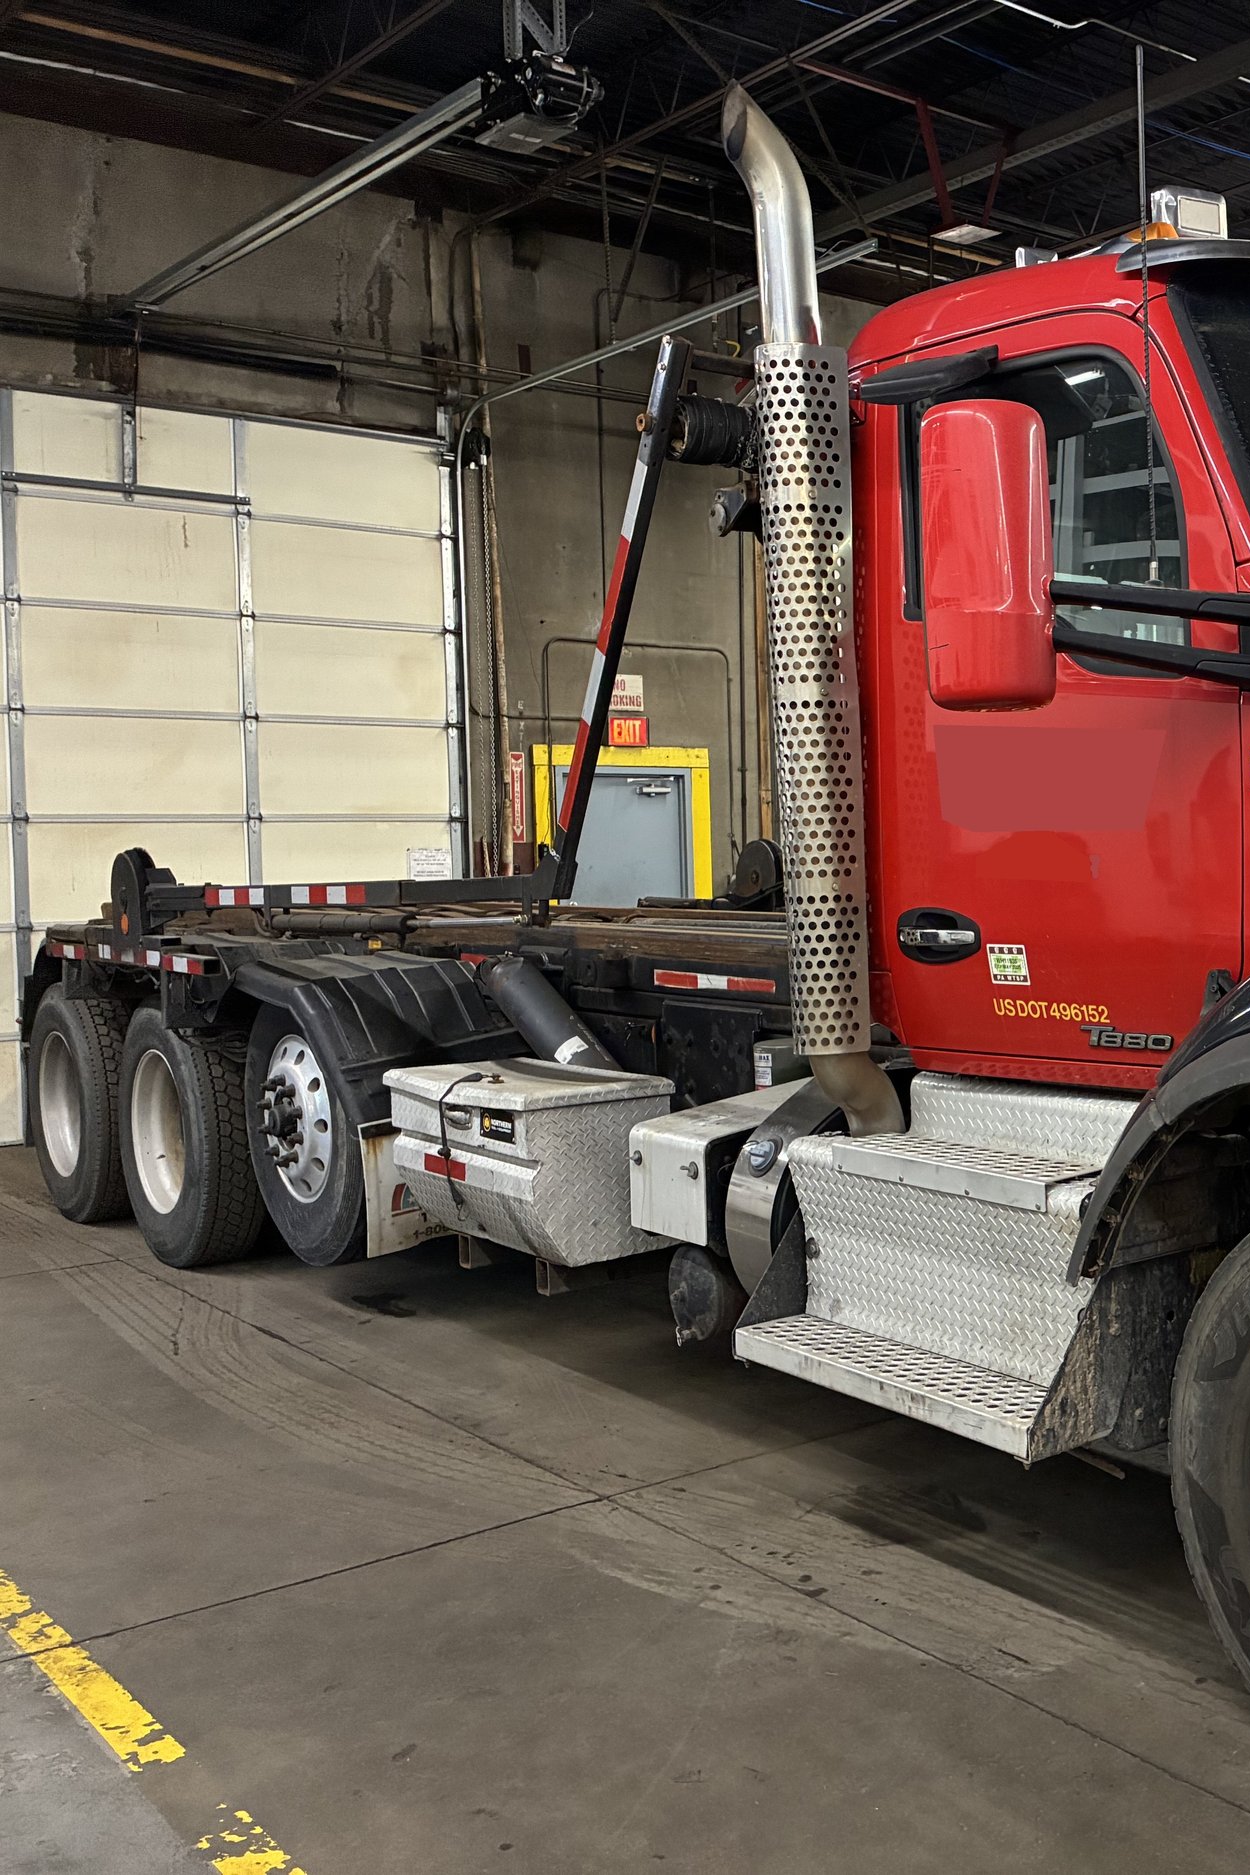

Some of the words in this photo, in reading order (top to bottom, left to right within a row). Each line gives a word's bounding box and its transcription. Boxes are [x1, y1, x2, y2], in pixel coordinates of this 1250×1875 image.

[610, 695, 642, 707] OKING
[613, 719, 642, 743] EXIT
[1080, 1025, 1174, 1051] T880
